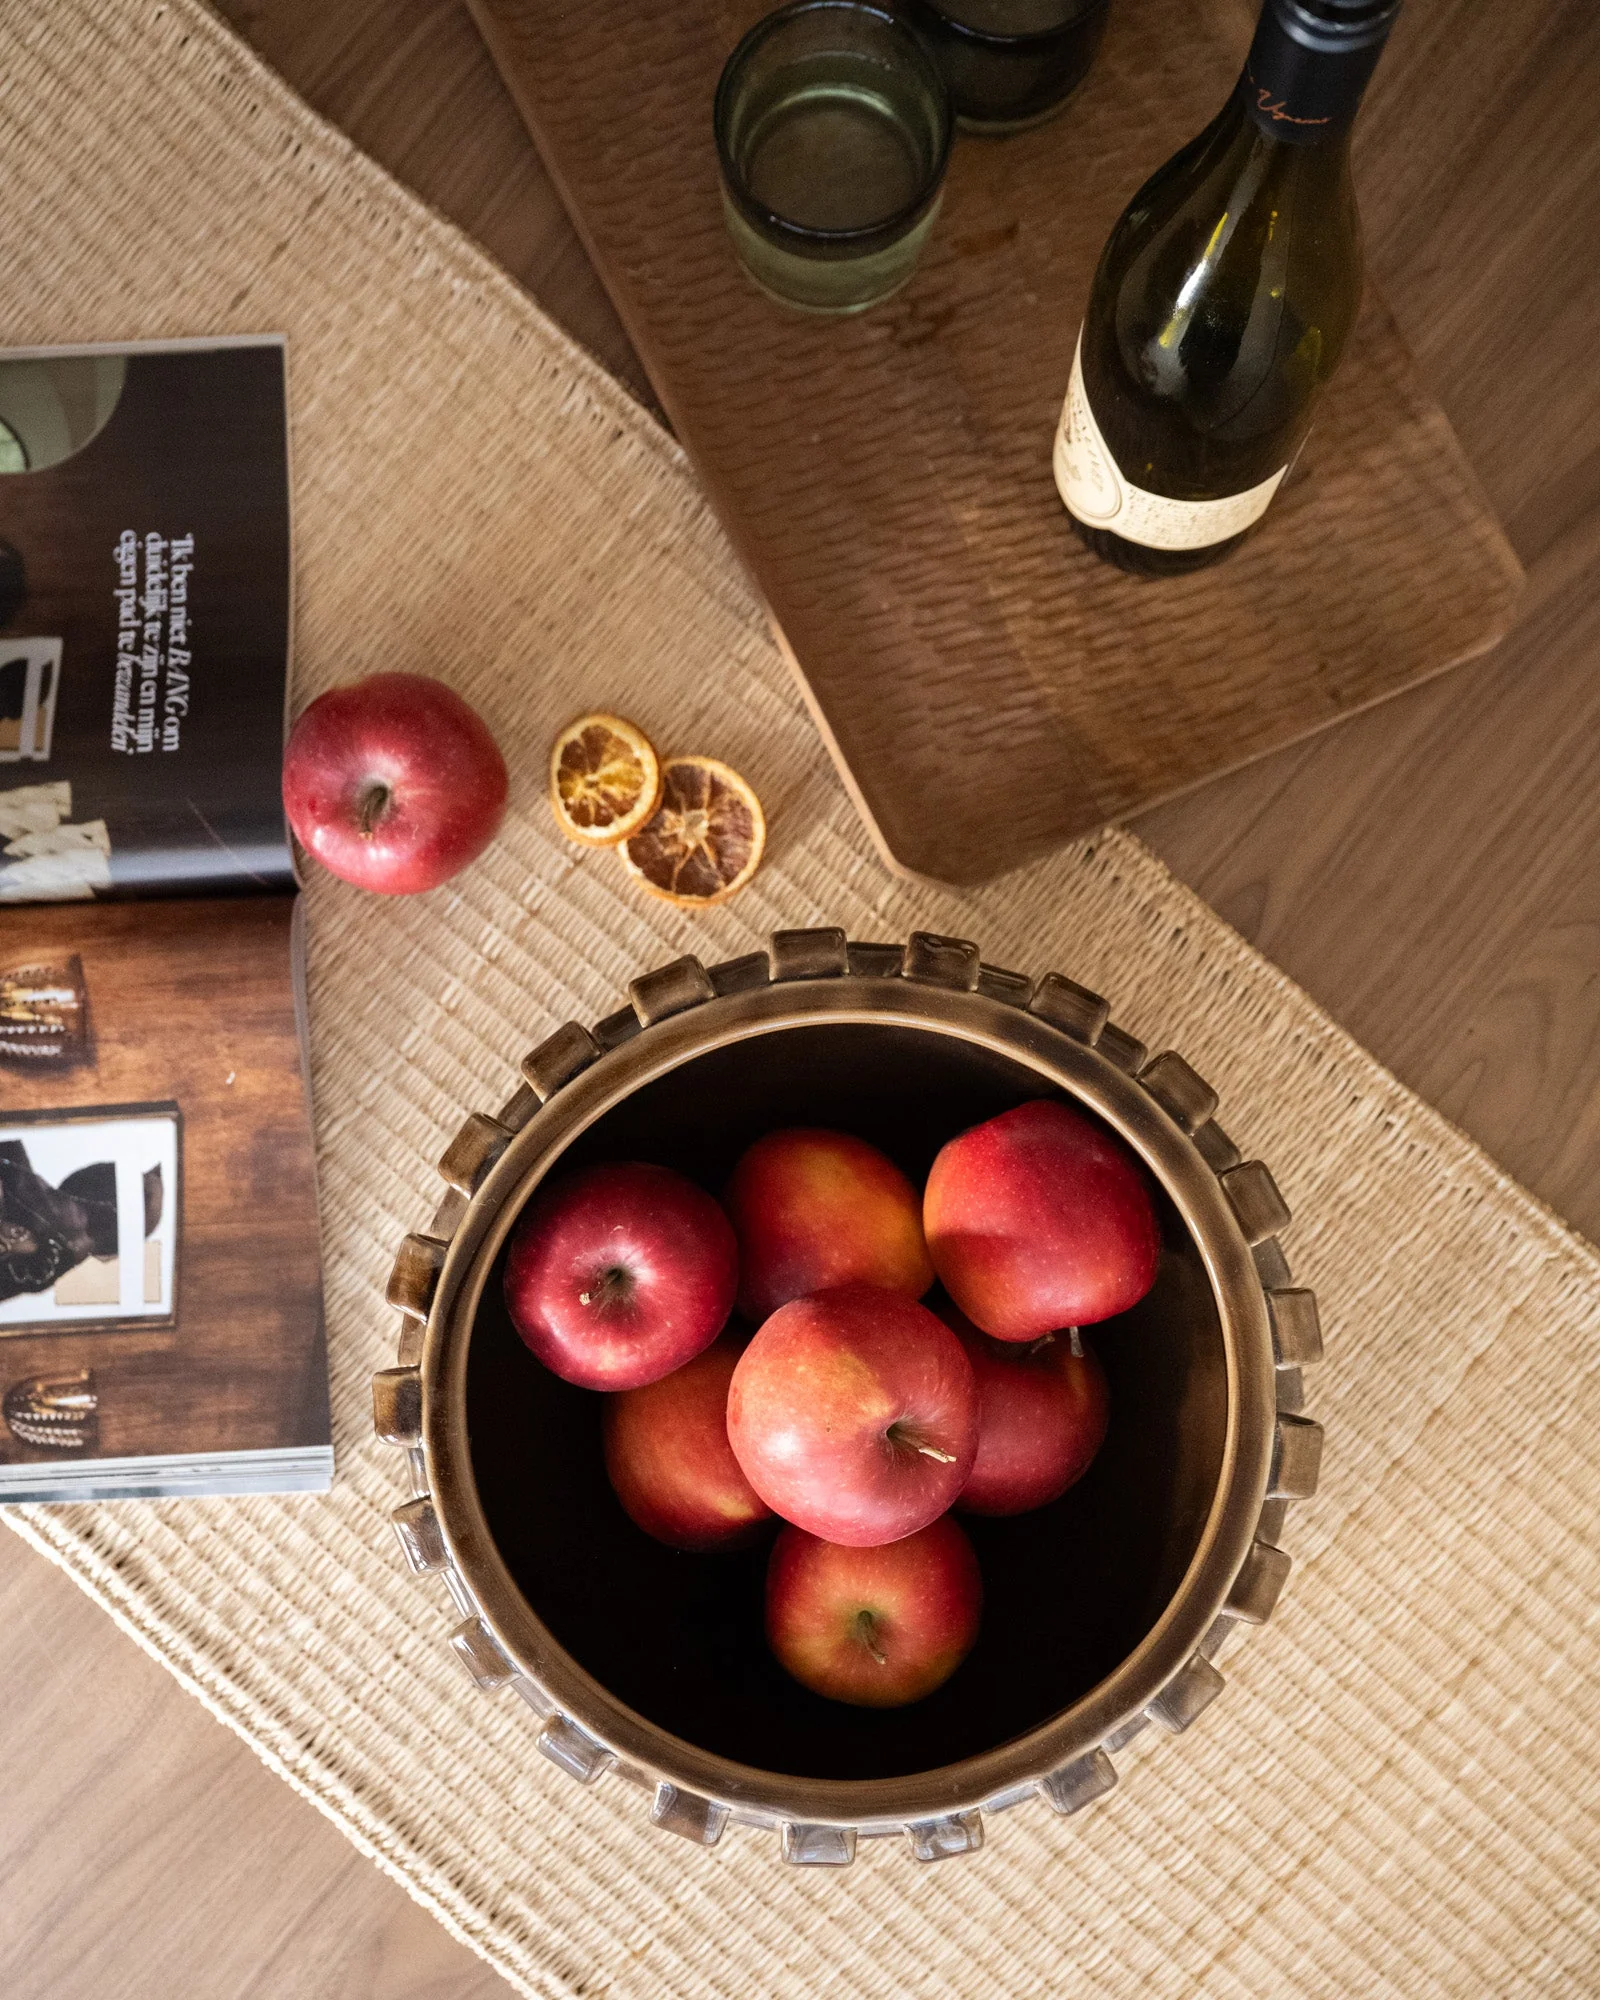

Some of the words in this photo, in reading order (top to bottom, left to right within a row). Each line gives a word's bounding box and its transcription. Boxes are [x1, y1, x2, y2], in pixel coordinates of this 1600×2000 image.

[113, 529, 142, 585] eigen
[139, 532, 169, 618] duidelijk
[170, 563, 194, 602] ben
[113, 589, 142, 628] pad
[169, 607, 192, 645] niet
[117, 630, 136, 651] te
[144, 621, 163, 641] te
[141, 644, 164, 678] zijn
[139, 680, 156, 704] en
[164, 647, 191, 716] BANG
[131, 708, 160, 752] mijn
[162, 716, 180, 752] om
